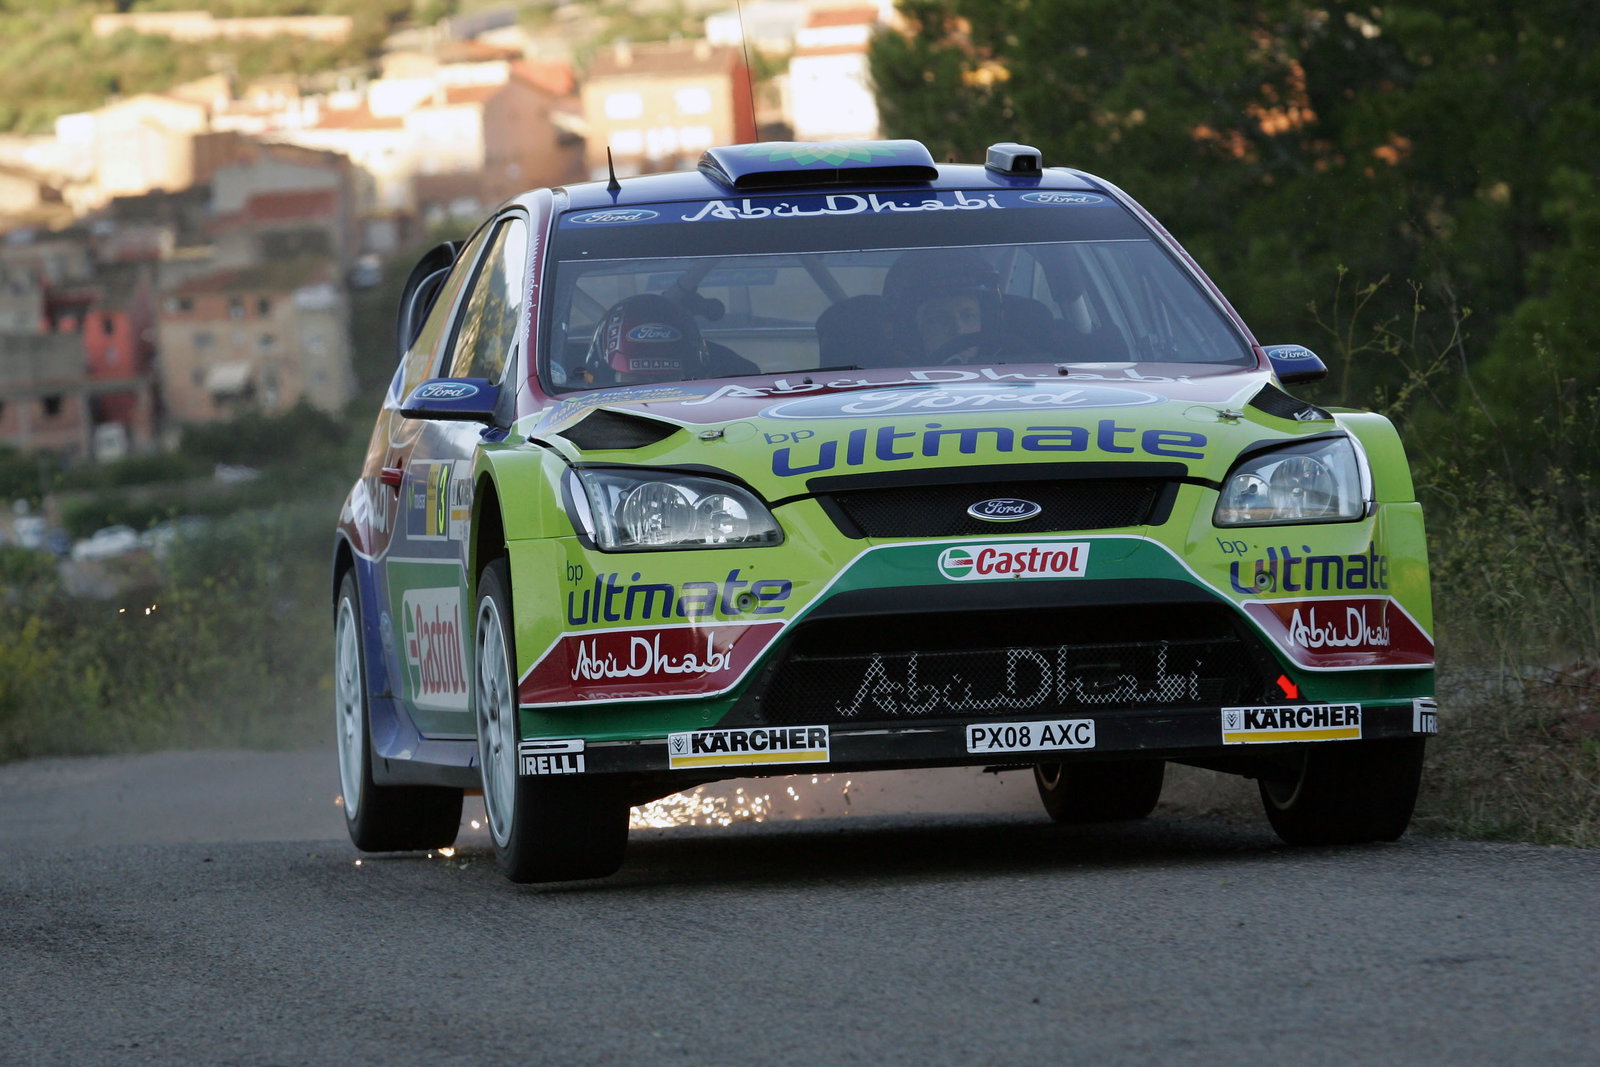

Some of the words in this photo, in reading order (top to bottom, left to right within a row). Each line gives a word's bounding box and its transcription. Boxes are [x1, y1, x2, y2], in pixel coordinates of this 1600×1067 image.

[1034, 192, 1091, 205] Ford
[584, 209, 646, 224] Ford
[1279, 349, 1311, 359] Ford
[423, 383, 468, 398] Ford
[841, 385, 1087, 414] Ford
[763, 429, 816, 445] bp
[772, 420, 1207, 477] ultimate
[438, 464, 448, 534] 3
[984, 500, 1026, 516] Ford
[1217, 538, 1249, 556] bp
[567, 560, 583, 585] bp
[976, 546, 1079, 574] Castrol
[567, 568, 793, 626] ultimate
[416, 603, 468, 694] Castrol
[1244, 705, 1359, 730] KÄRCHER
[691, 728, 827, 754] KÄRCHER
[971, 725, 1031, 750] PX08
[1040, 722, 1091, 746] AXC
